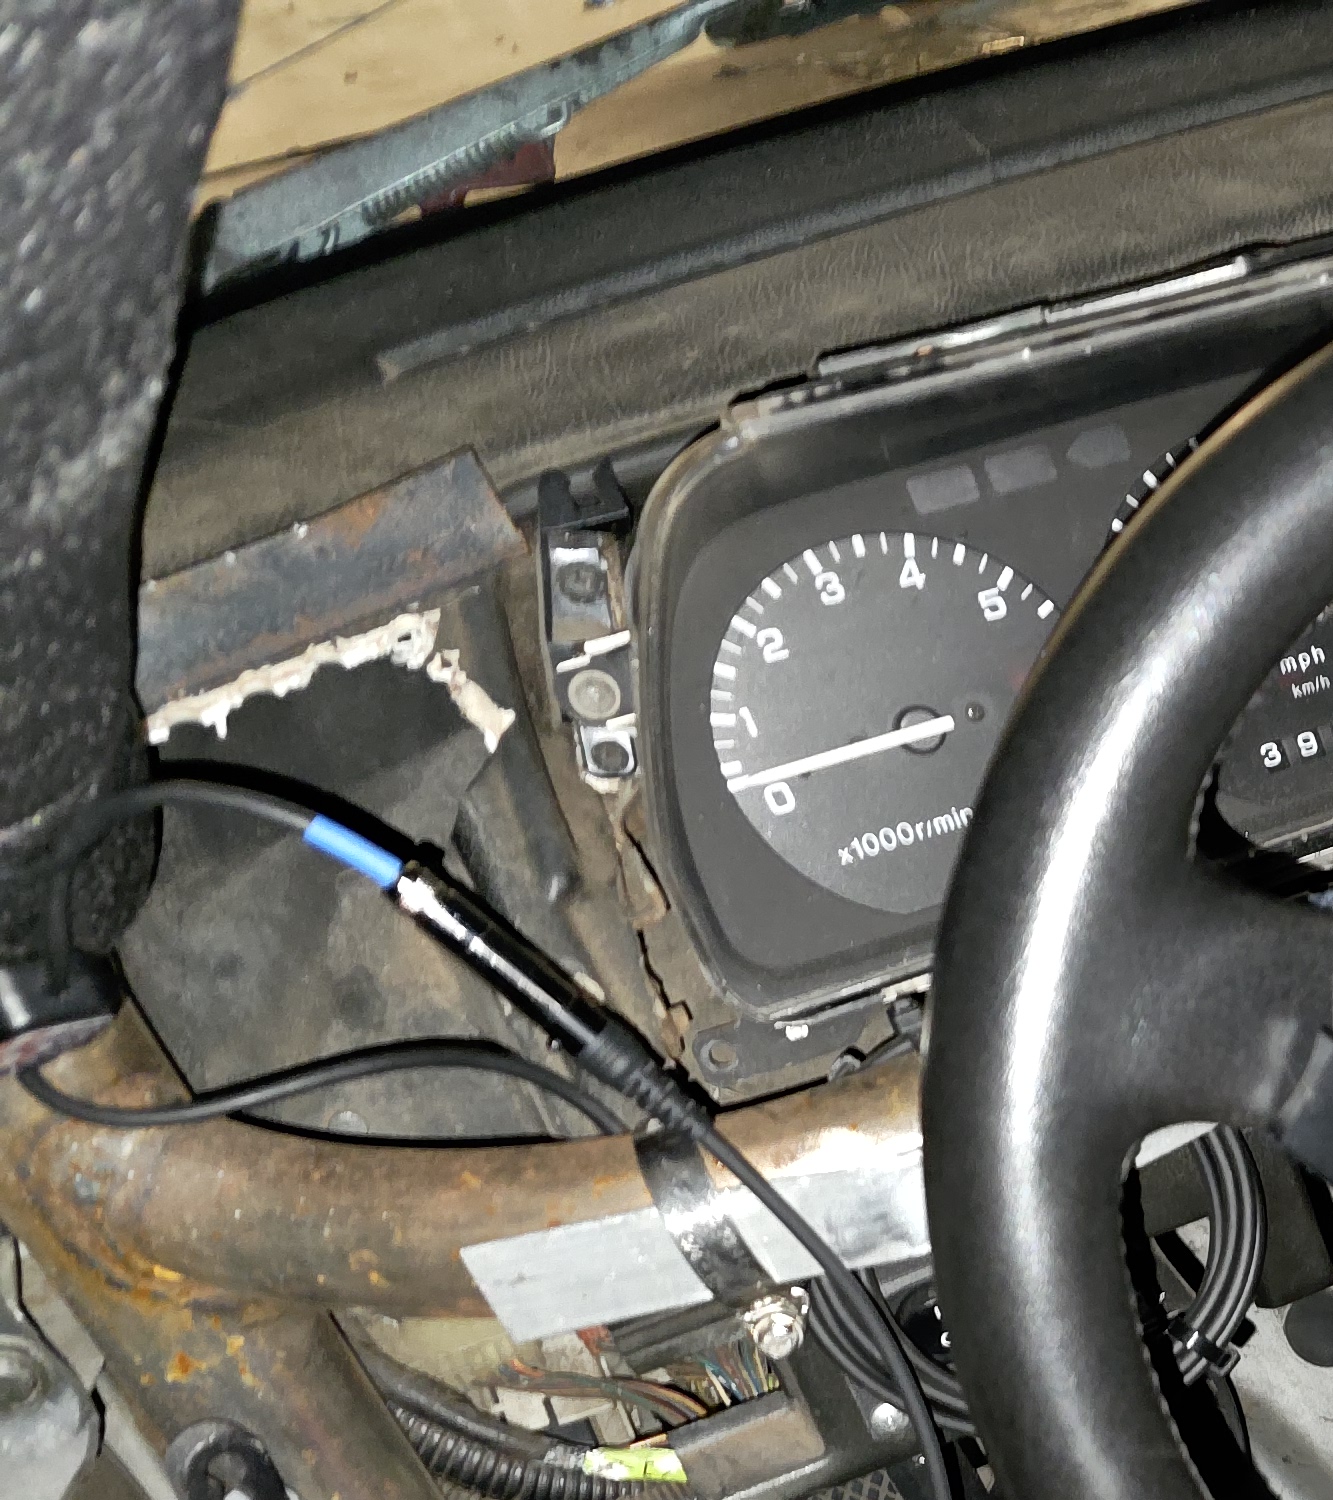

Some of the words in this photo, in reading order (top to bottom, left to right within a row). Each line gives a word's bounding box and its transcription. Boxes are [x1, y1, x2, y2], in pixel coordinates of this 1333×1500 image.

[815, 571, 845, 605] 3
[899, 557, 926, 590] 4
[978, 587, 1007, 621] 5
[757, 627, 790, 663] 2
[1280, 645, 1326, 674] mph
[1291, 675, 1331, 698] km/h
[739, 706, 758, 738] 1
[764, 781, 796, 815] 0
[838, 806, 974, 865] x1000r/min
